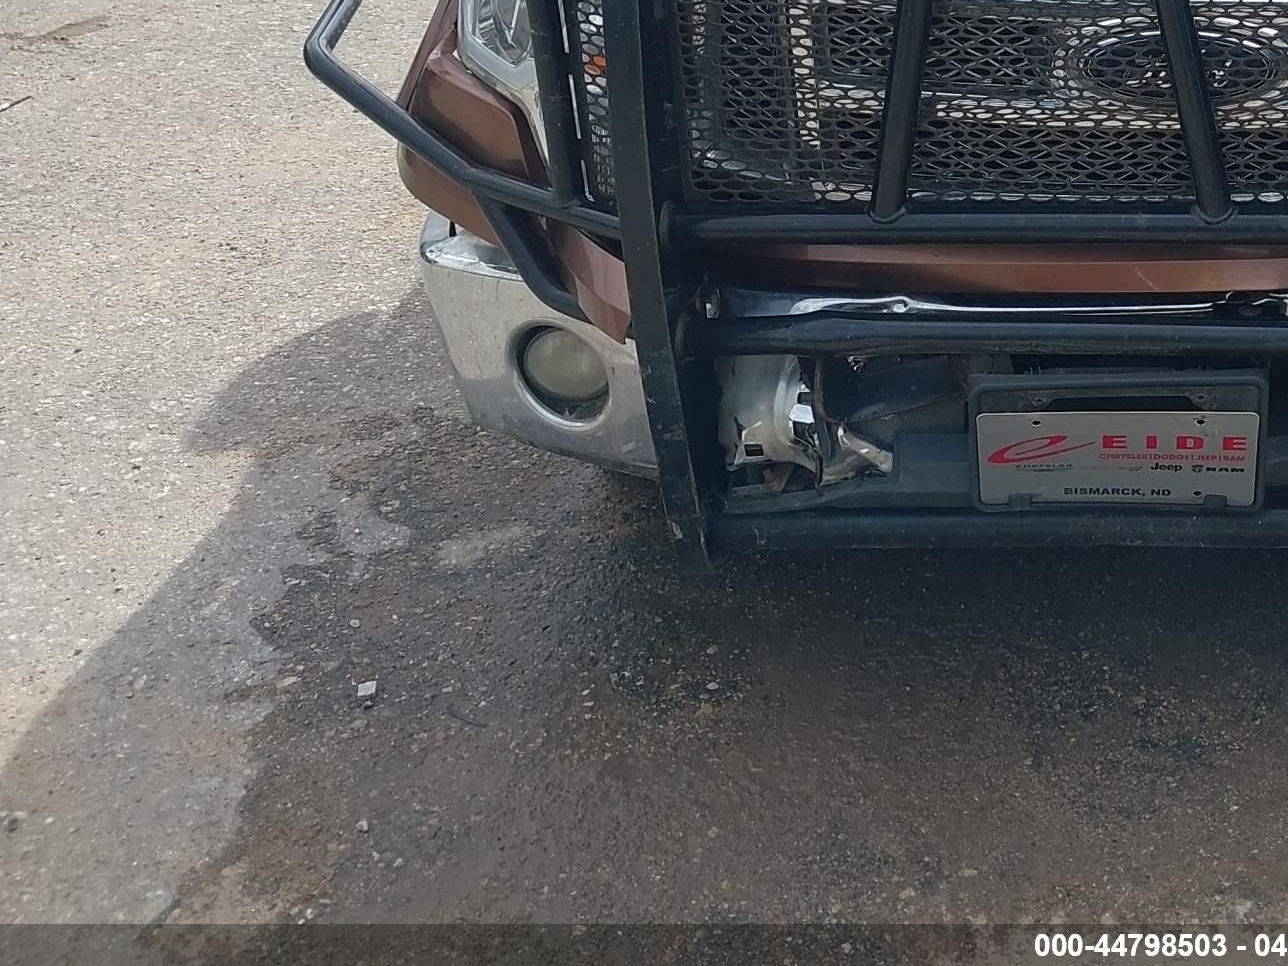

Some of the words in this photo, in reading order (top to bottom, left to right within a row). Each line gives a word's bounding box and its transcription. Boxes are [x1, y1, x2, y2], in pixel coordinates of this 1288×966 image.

[1102, 435, 1247, 451] EIDE
[1150, 462, 1183, 473] Jeep
[1063, 487, 1146, 497] BISMARCK,
[1150, 488, 1172, 497] ND
